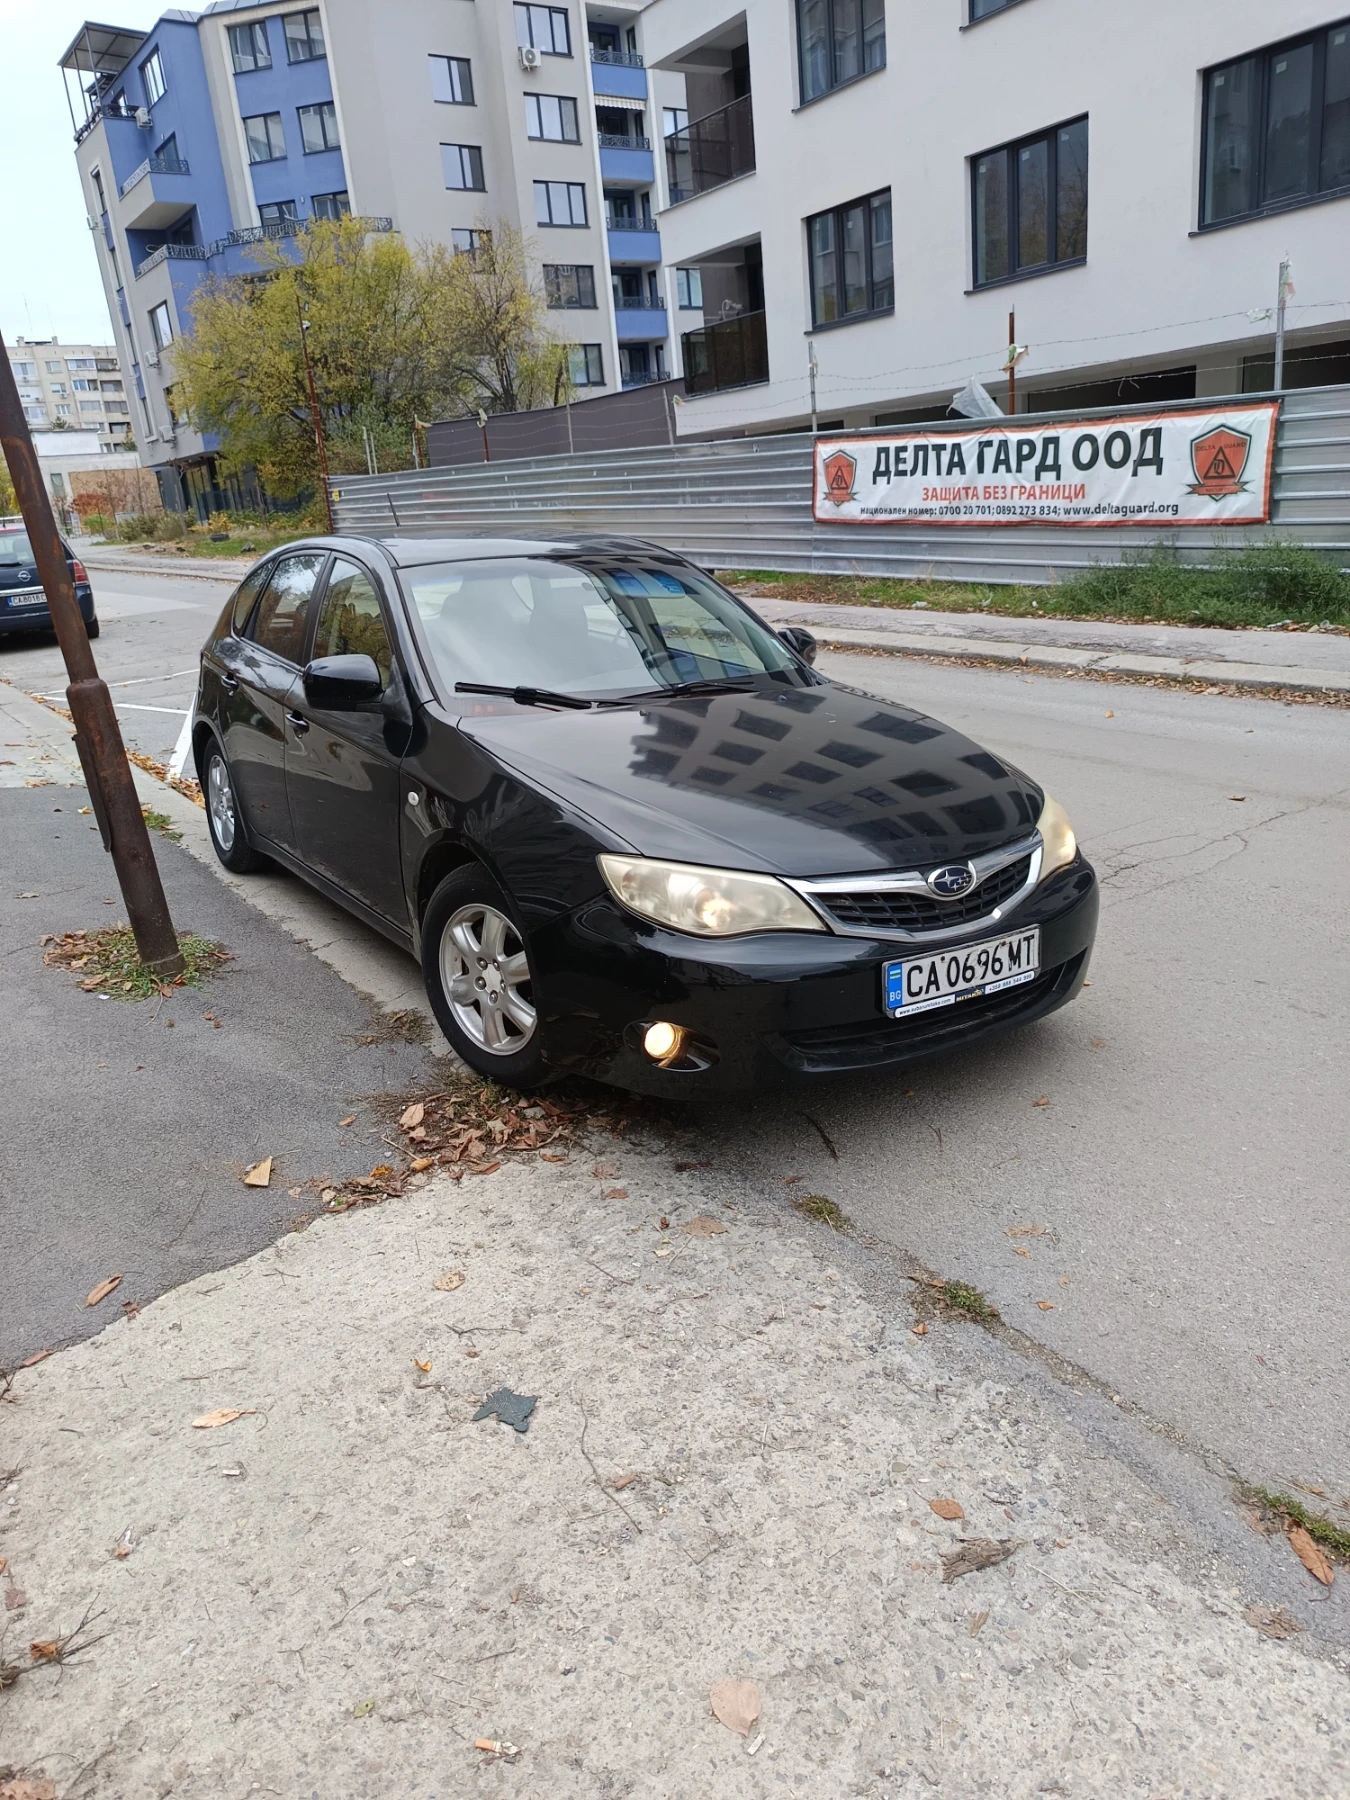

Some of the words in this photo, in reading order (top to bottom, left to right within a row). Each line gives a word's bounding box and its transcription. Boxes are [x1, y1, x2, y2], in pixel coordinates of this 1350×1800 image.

[872, 443, 966, 485] ДЕЛТА
[976, 436, 1062, 482] ГАРД
[1072, 427, 1164, 477] ООД
[1195, 444, 1216, 452] DELTA
[922, 486, 979, 504] ЗАЩИТА
[983, 485, 1007, 500] БЕЗ
[1010, 484, 1086, 503] ГРАНИЦИ
[908, 507, 937, 518] номер:
[938, 506, 960, 515] 0700
[963, 505, 973, 515] 20
[1019, 505, 1036, 515] 273
[1039, 505, 1061, 517] 834;
[1063, 501, 1179, 517] www.deltaguard.org
[889, 990, 902, 1002] BG
